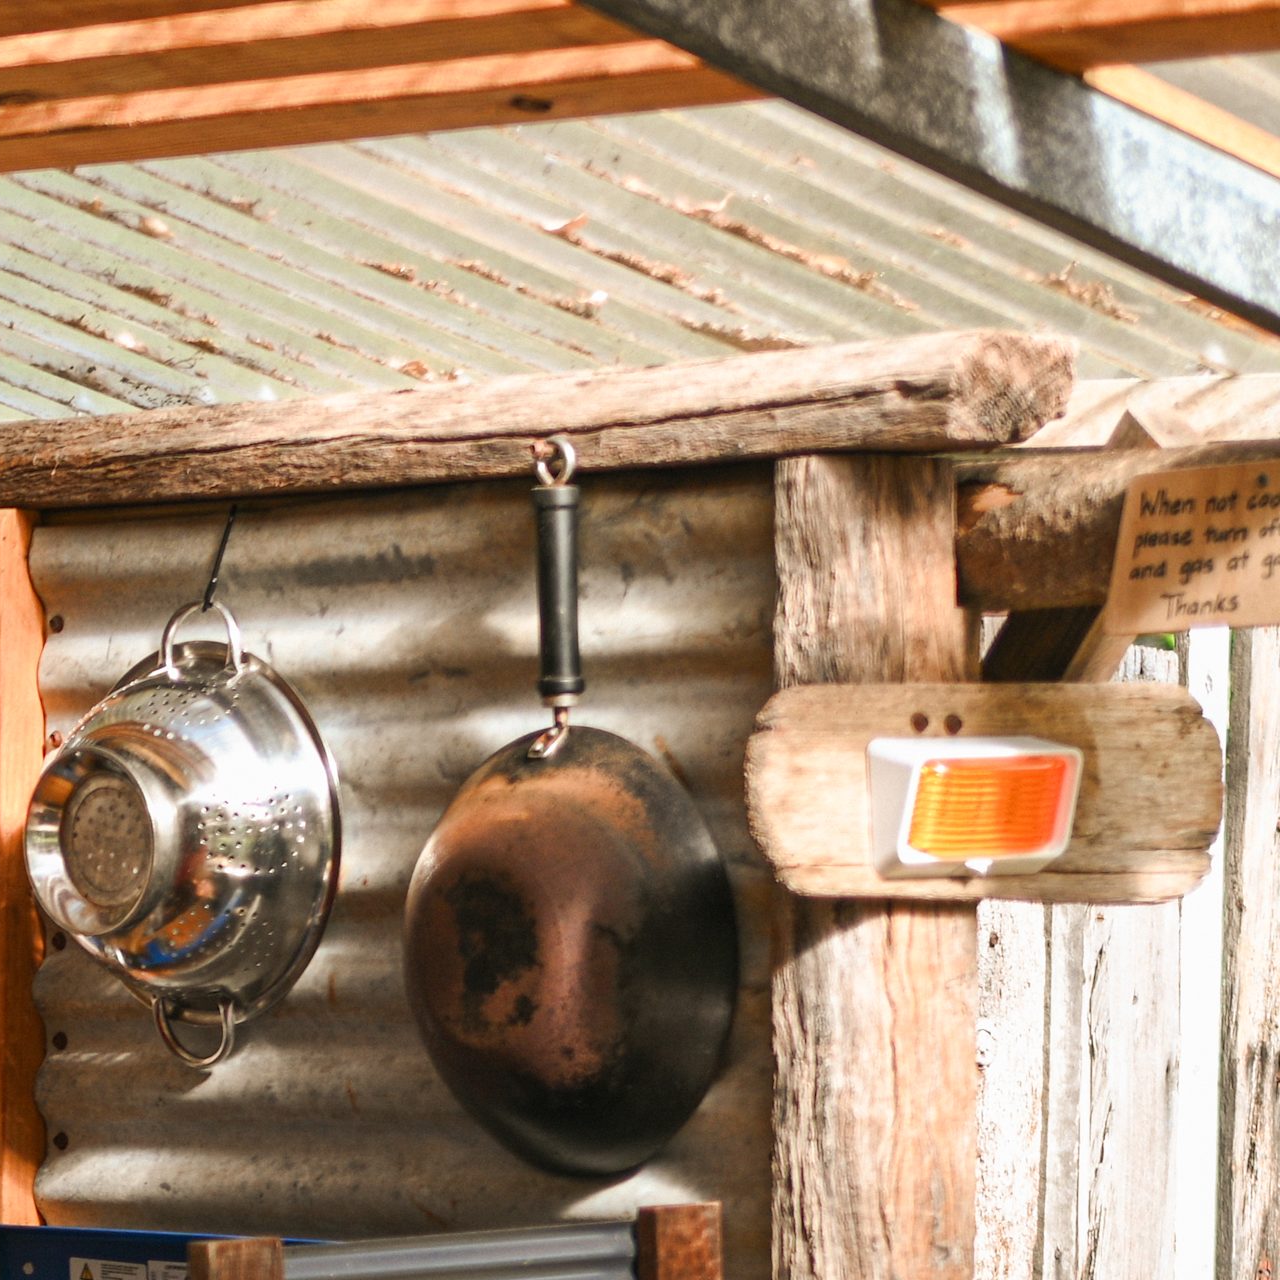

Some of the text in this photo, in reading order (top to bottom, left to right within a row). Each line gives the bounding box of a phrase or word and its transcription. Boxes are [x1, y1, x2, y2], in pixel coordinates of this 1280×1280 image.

[1140, 489, 1195, 516] When
[1204, 491, 1237, 514] not
[1132, 529, 1193, 559] please
[1204, 527, 1248, 544] turn
[1129, 561, 1168, 580] and
[1179, 558, 1214, 586] gas
[1226, 551, 1249, 572] at
[1160, 592, 1239, 619] Thanks
